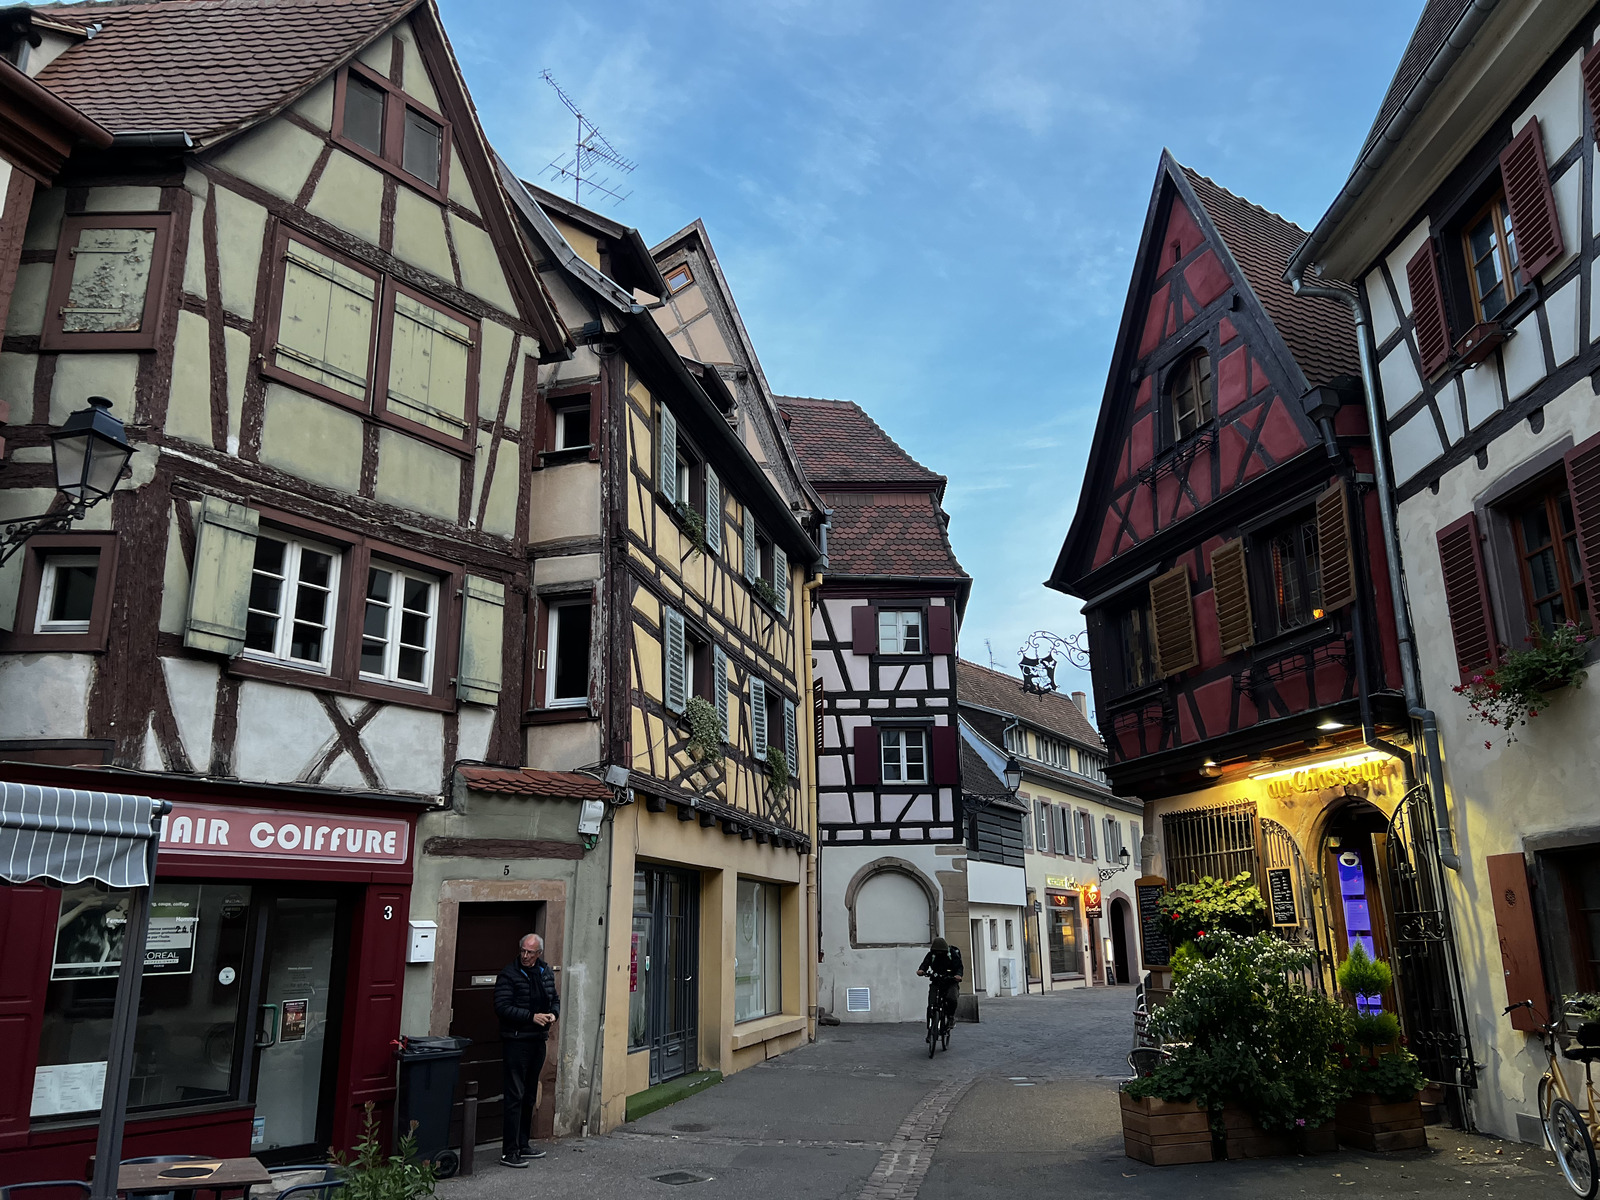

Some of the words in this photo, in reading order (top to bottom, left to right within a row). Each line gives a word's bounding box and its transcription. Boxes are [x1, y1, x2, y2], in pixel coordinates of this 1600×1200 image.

[1291, 759, 1385, 793] Chasseur
[250, 821, 397, 855] COIFFURE
[503, 865, 510, 876] 5
[383, 905, 393, 920] 3
